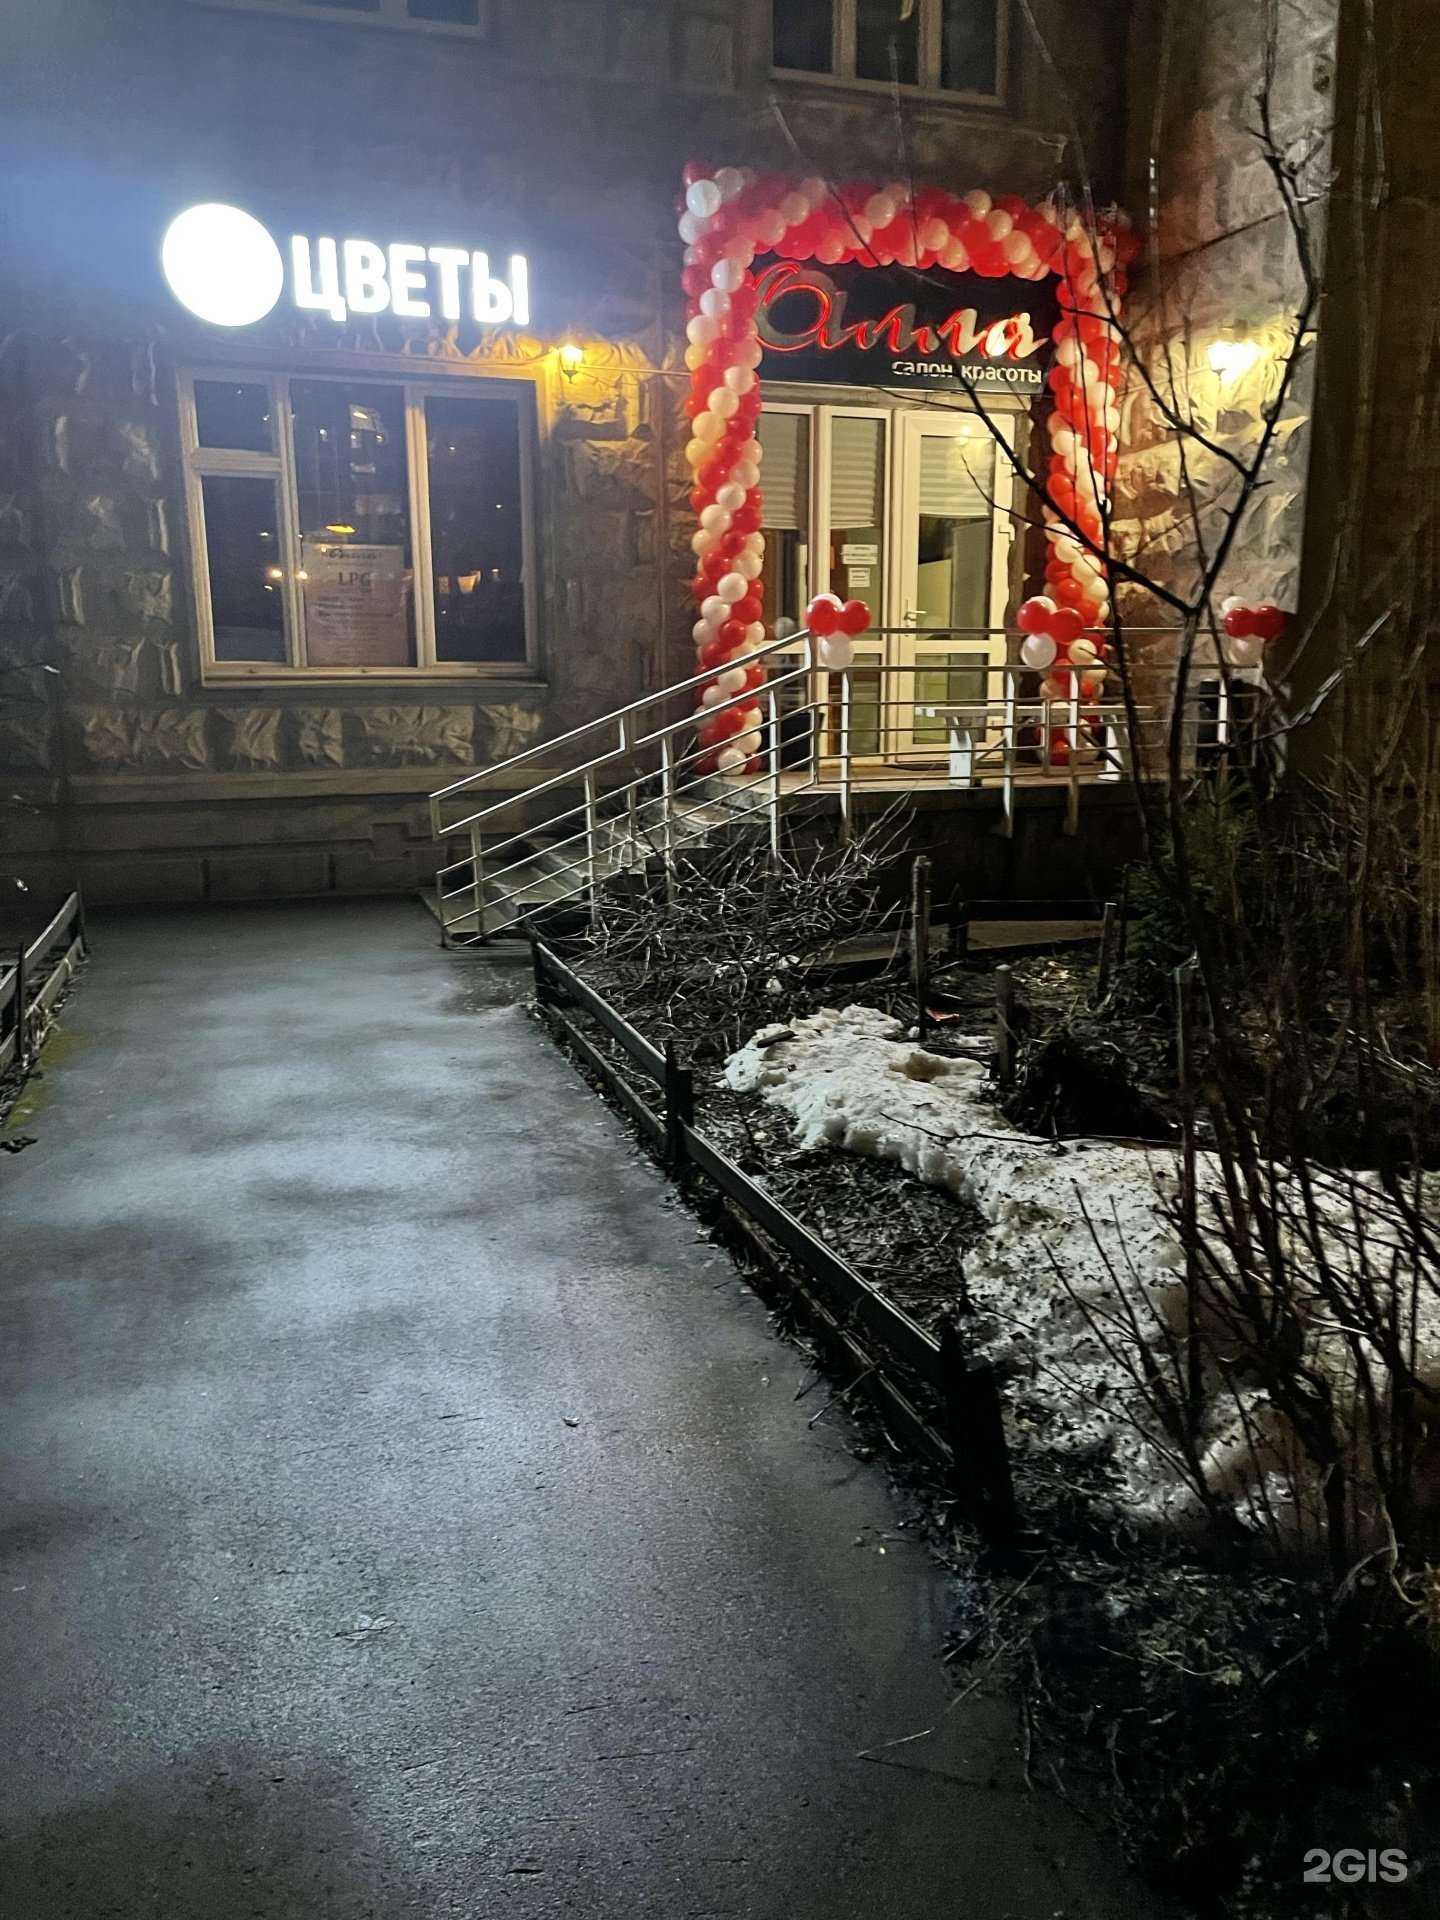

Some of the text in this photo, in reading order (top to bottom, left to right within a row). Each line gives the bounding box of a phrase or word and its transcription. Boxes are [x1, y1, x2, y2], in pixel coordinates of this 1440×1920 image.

[292, 235, 529, 325] ЦВЕТЫ
[892, 361, 1042, 383] салон красоты
